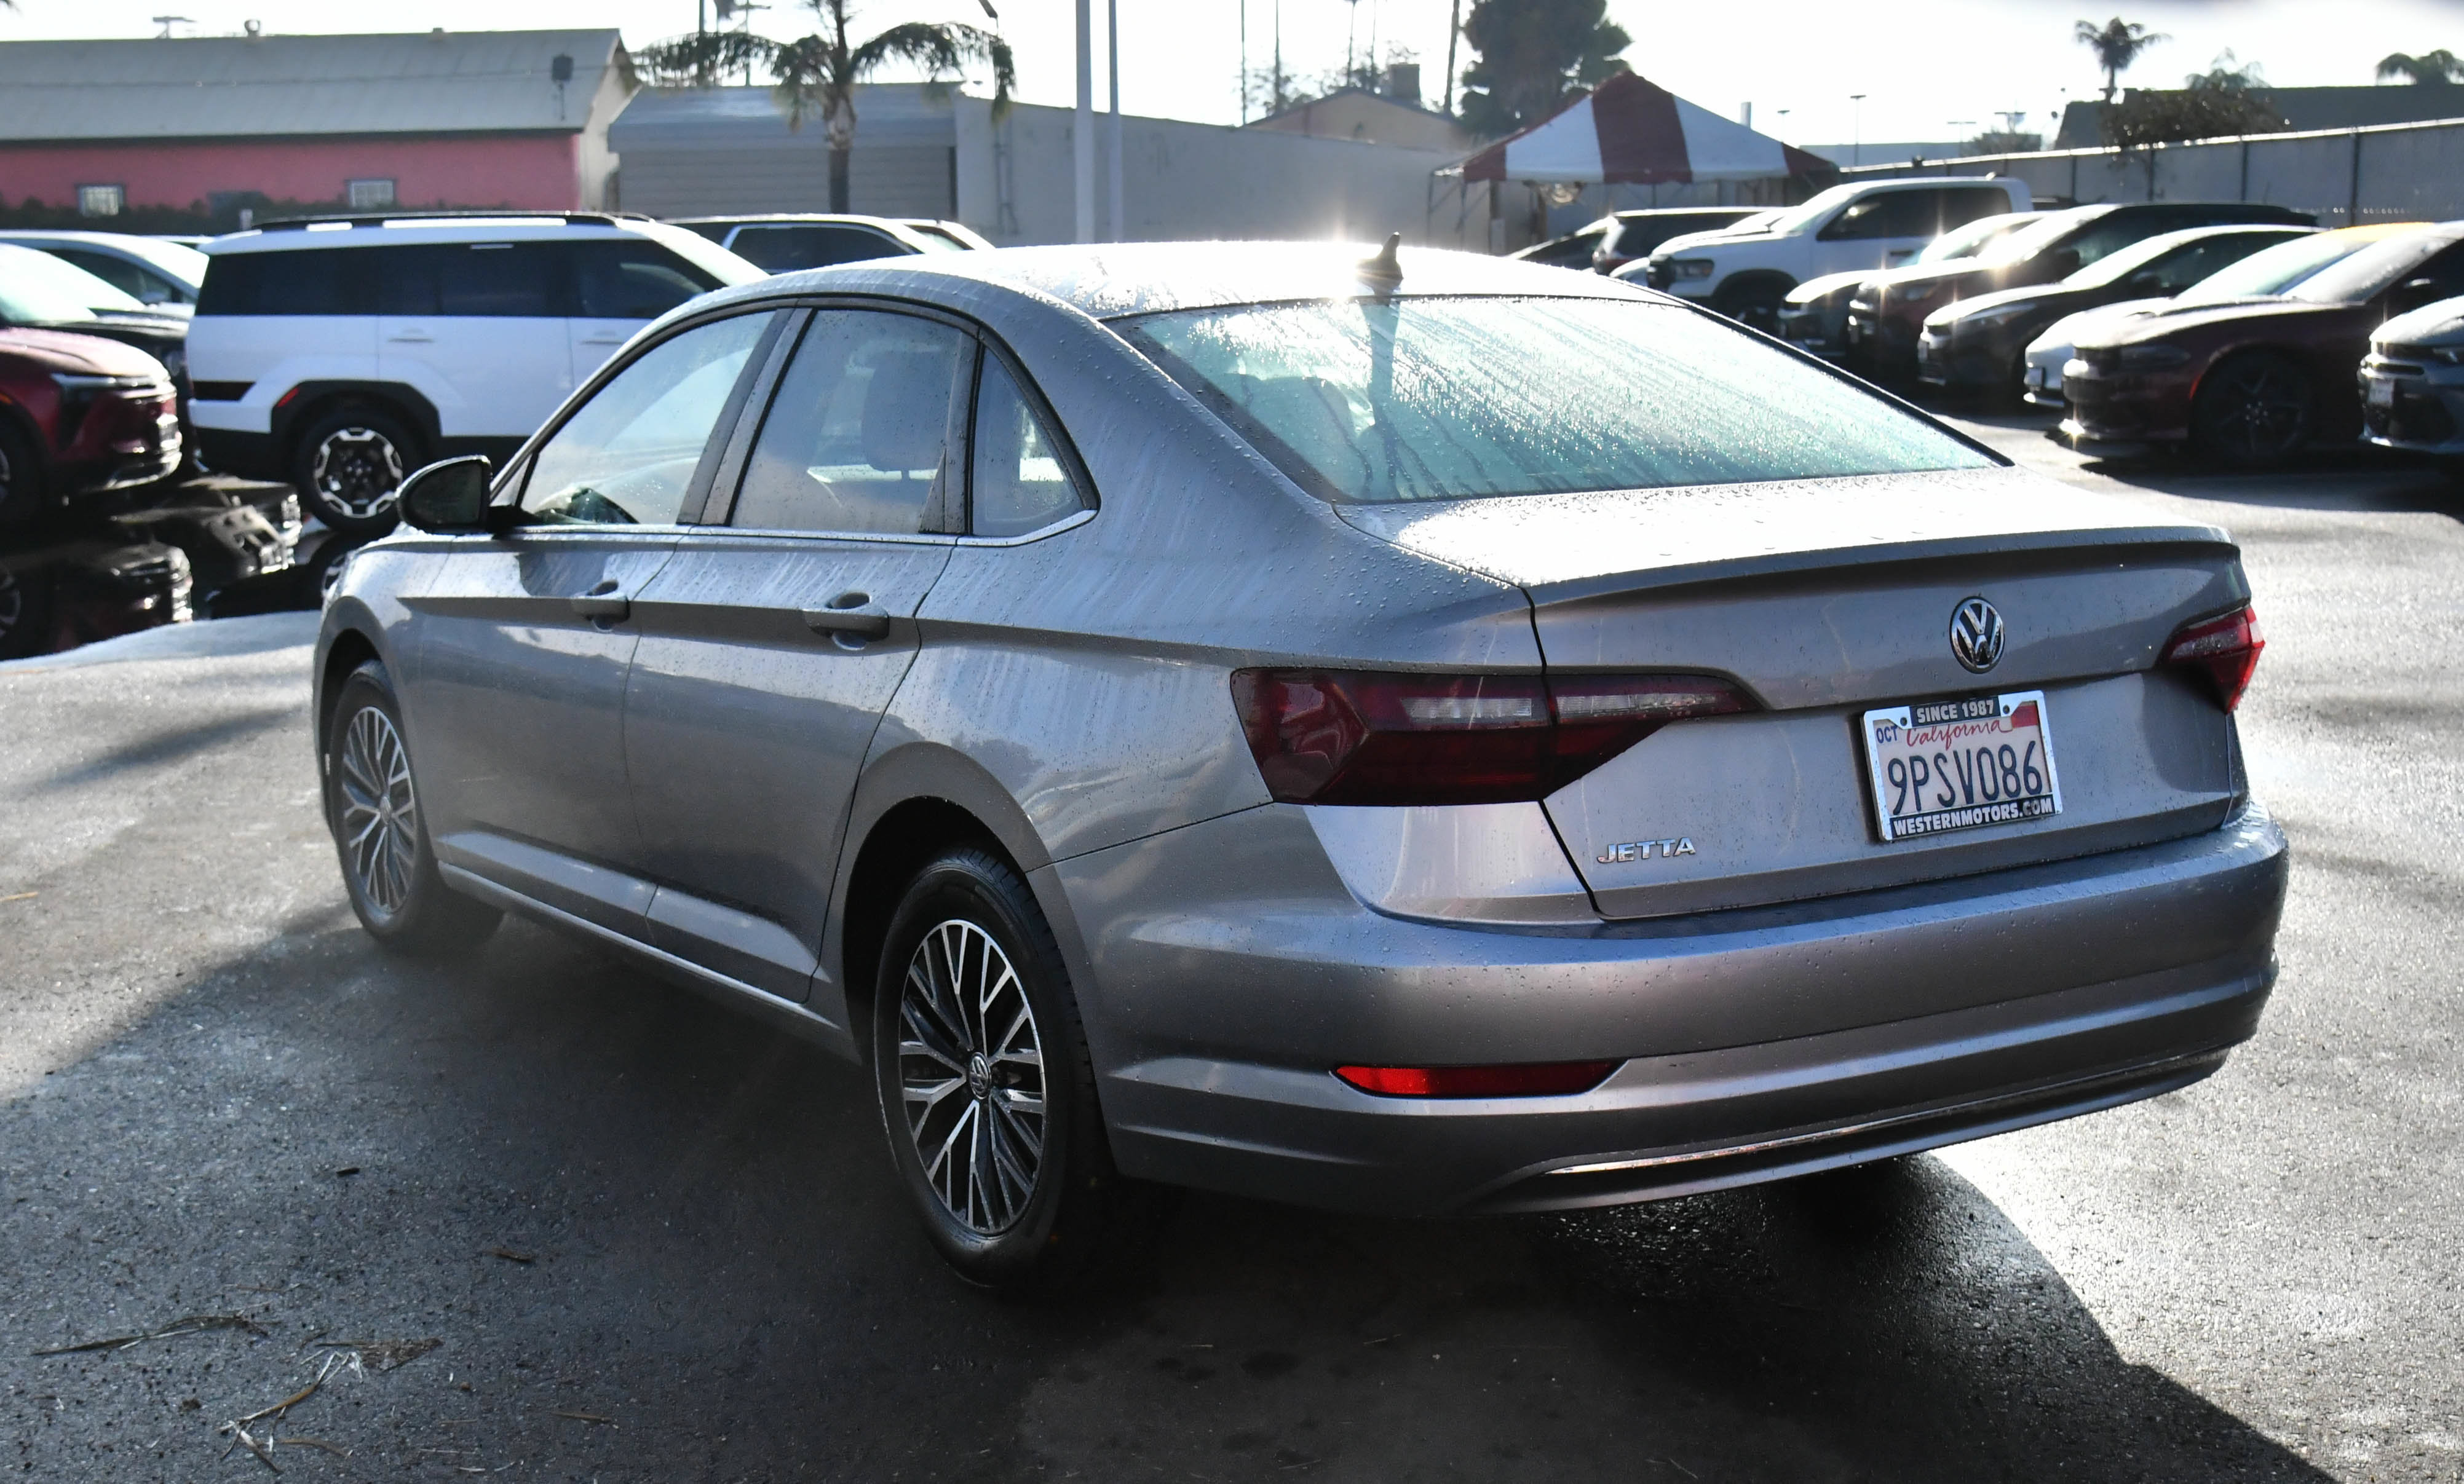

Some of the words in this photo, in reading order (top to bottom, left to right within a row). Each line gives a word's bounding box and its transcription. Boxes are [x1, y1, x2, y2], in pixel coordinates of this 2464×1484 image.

[1916, 704, 1958, 724] SINCE
[1962, 699, 1994, 718] 1987
[1876, 725, 1898, 744] OCT
[1887, 740, 2042, 815] 9PSV086
[1893, 798, 2053, 836] WESTERNMOTORS.COM
[1597, 837, 1696, 864] JETTA
